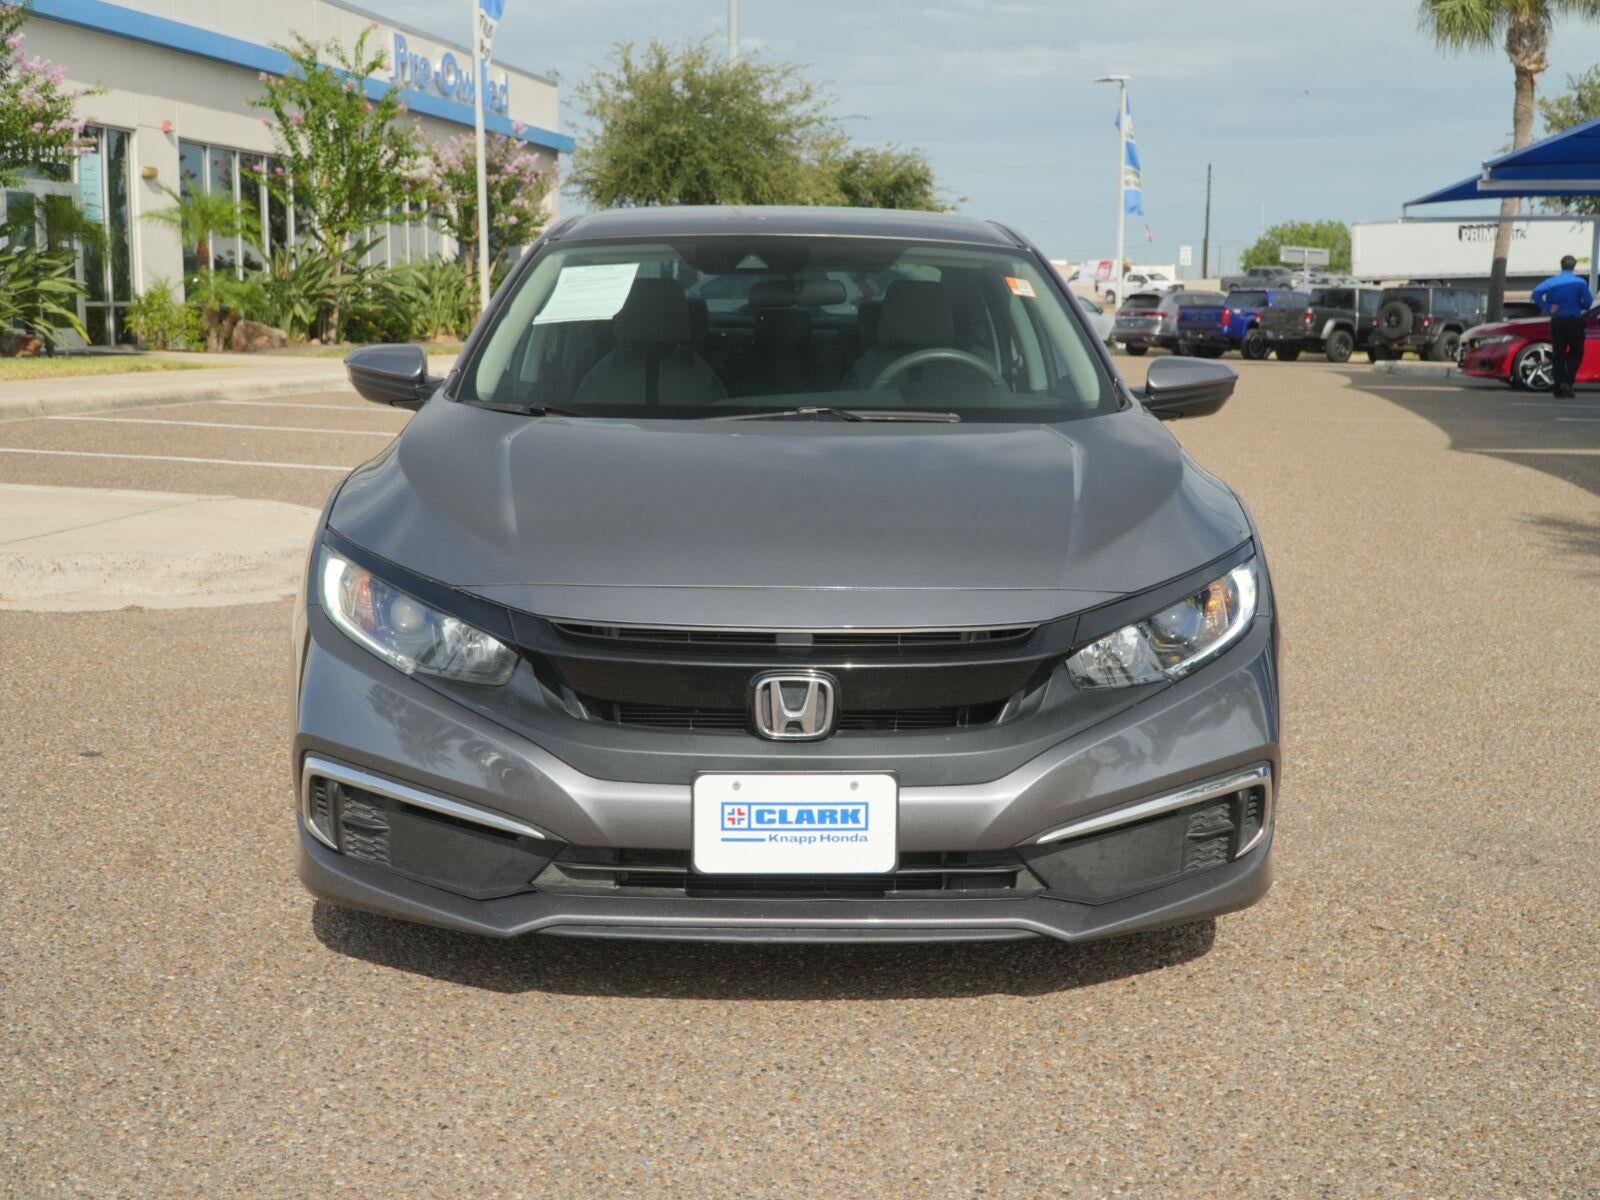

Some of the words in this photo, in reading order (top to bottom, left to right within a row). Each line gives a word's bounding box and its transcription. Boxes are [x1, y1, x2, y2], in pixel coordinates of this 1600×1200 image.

[393, 33, 508, 112] Pre-Owed
[1458, 224, 1501, 241] PRIM
[755, 808, 861, 825] CLARK
[768, 834, 817, 844] Knapp
[819, 833, 868, 843] Honda
